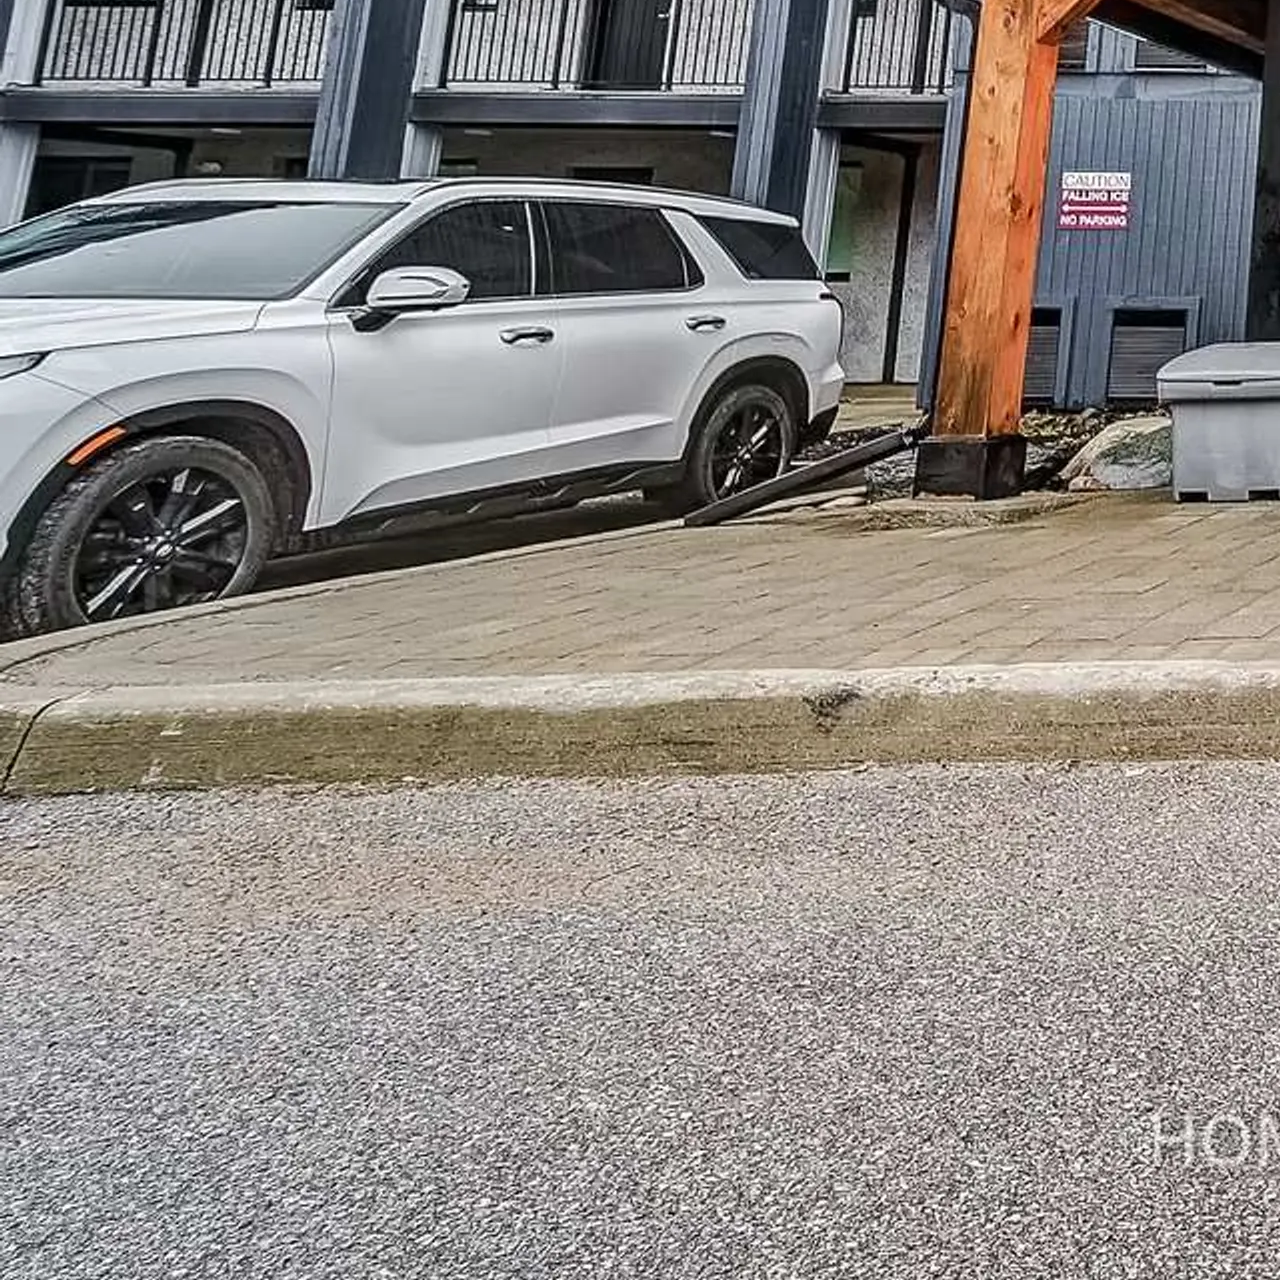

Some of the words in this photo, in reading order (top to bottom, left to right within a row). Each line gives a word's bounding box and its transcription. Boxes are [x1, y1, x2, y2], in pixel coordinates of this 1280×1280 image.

[1064, 174, 1129, 187] CAUTION
[1062, 190, 1108, 202] FALLING
[1110, 190, 1129, 202] ICE
[1060, 214, 1077, 226] NO
[1079, 214, 1127, 227] PARKING
